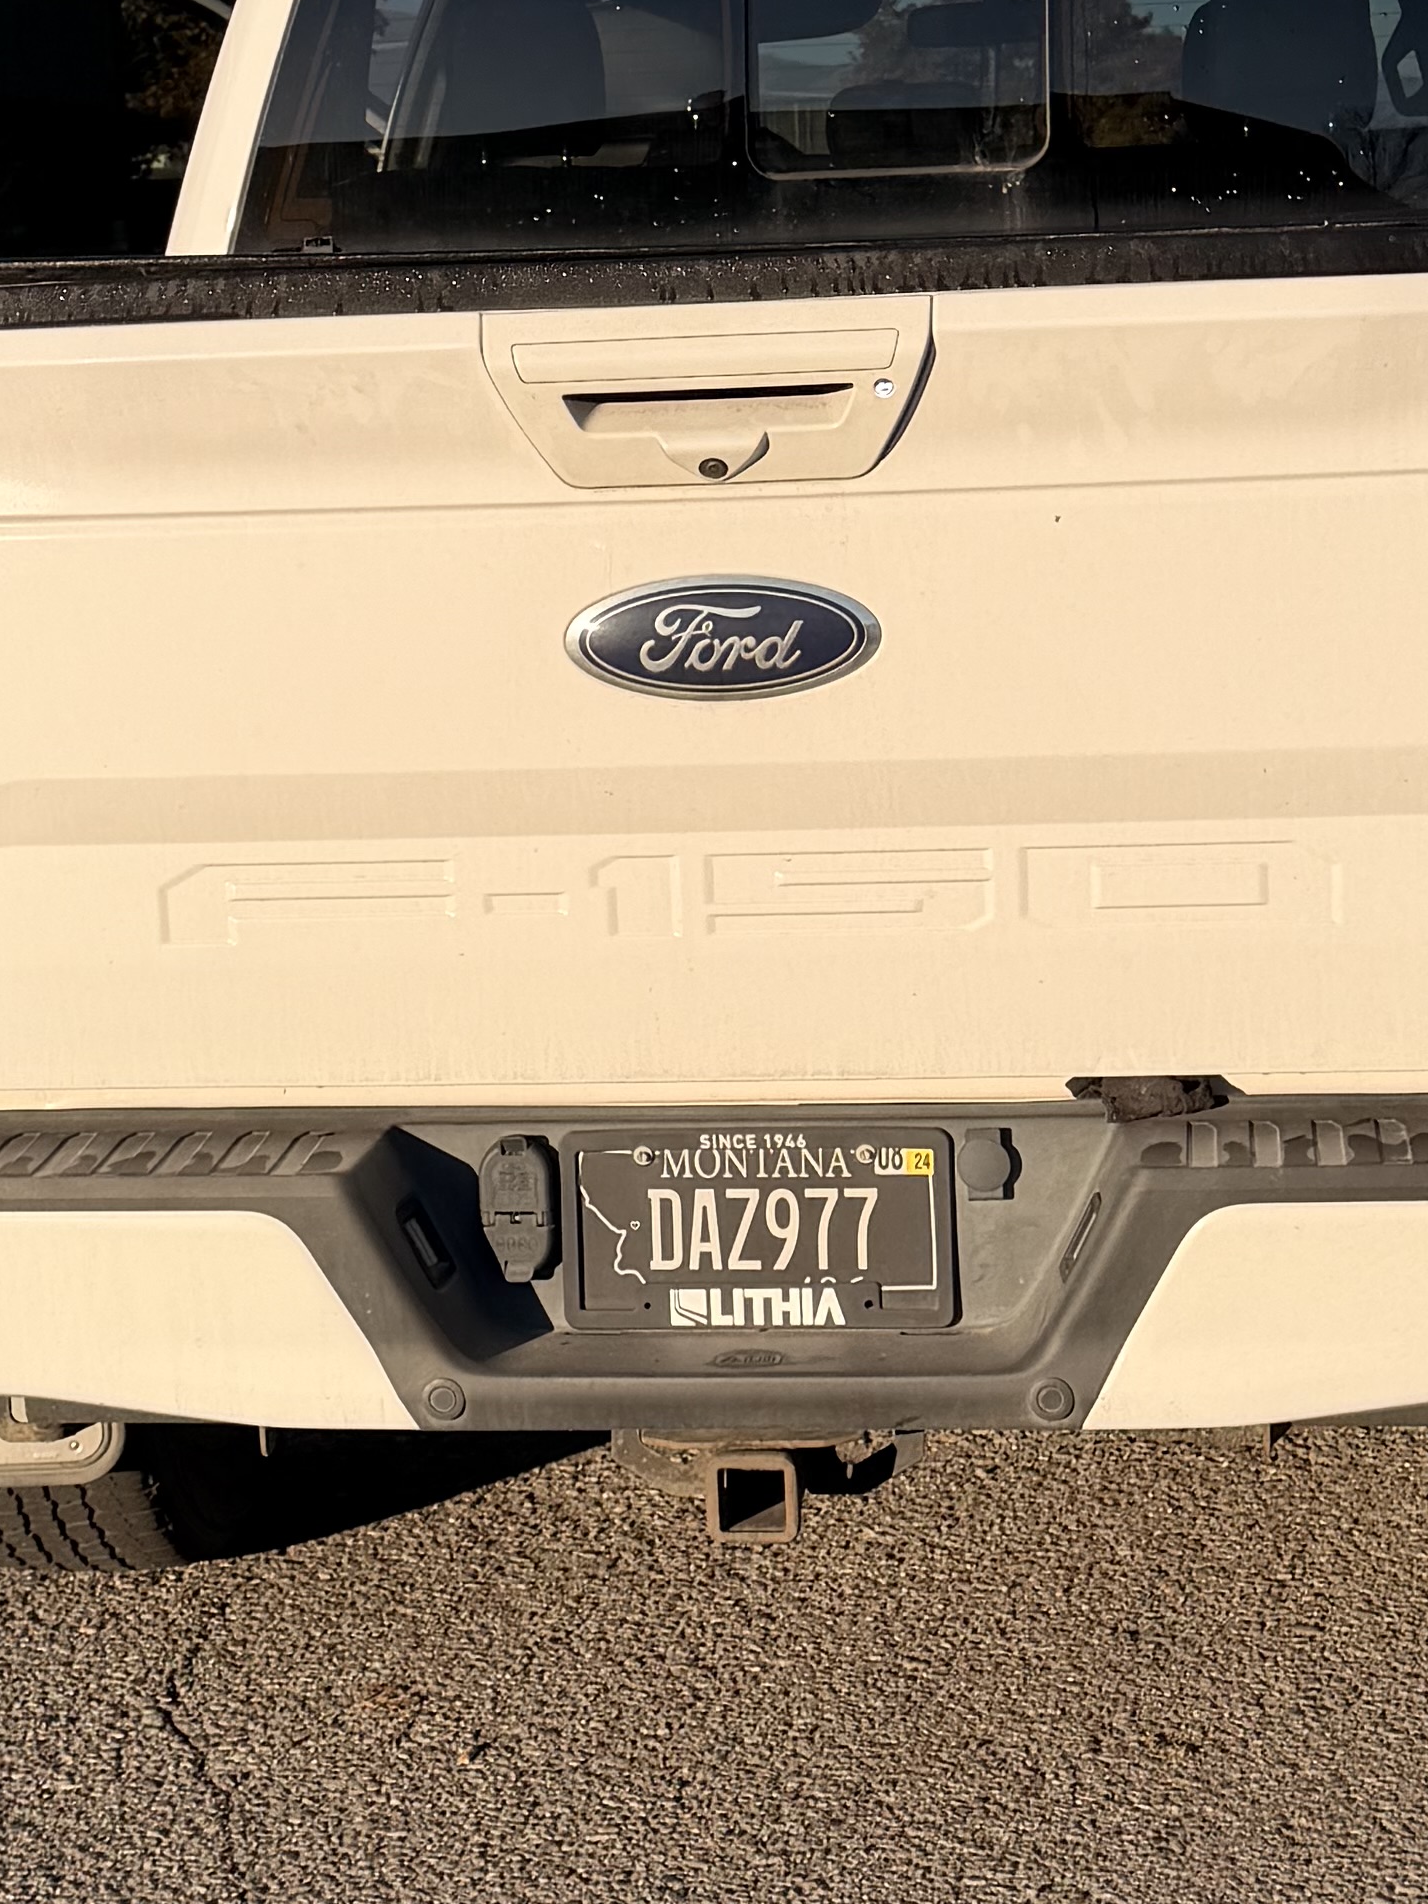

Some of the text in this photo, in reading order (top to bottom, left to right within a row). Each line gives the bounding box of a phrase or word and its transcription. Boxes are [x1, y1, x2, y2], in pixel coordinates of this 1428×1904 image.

[639, 604, 804, 673] Ford
[158, 840, 1345, 947] F-150
[699, 1133, 807, 1150] SINCE 1946
[914, 1152, 931, 1170] 24
[660, 1147, 852, 1179] MONTANA
[647, 1187, 878, 1271] DAZ977
[709, 1287, 846, 1327] LITHIA
